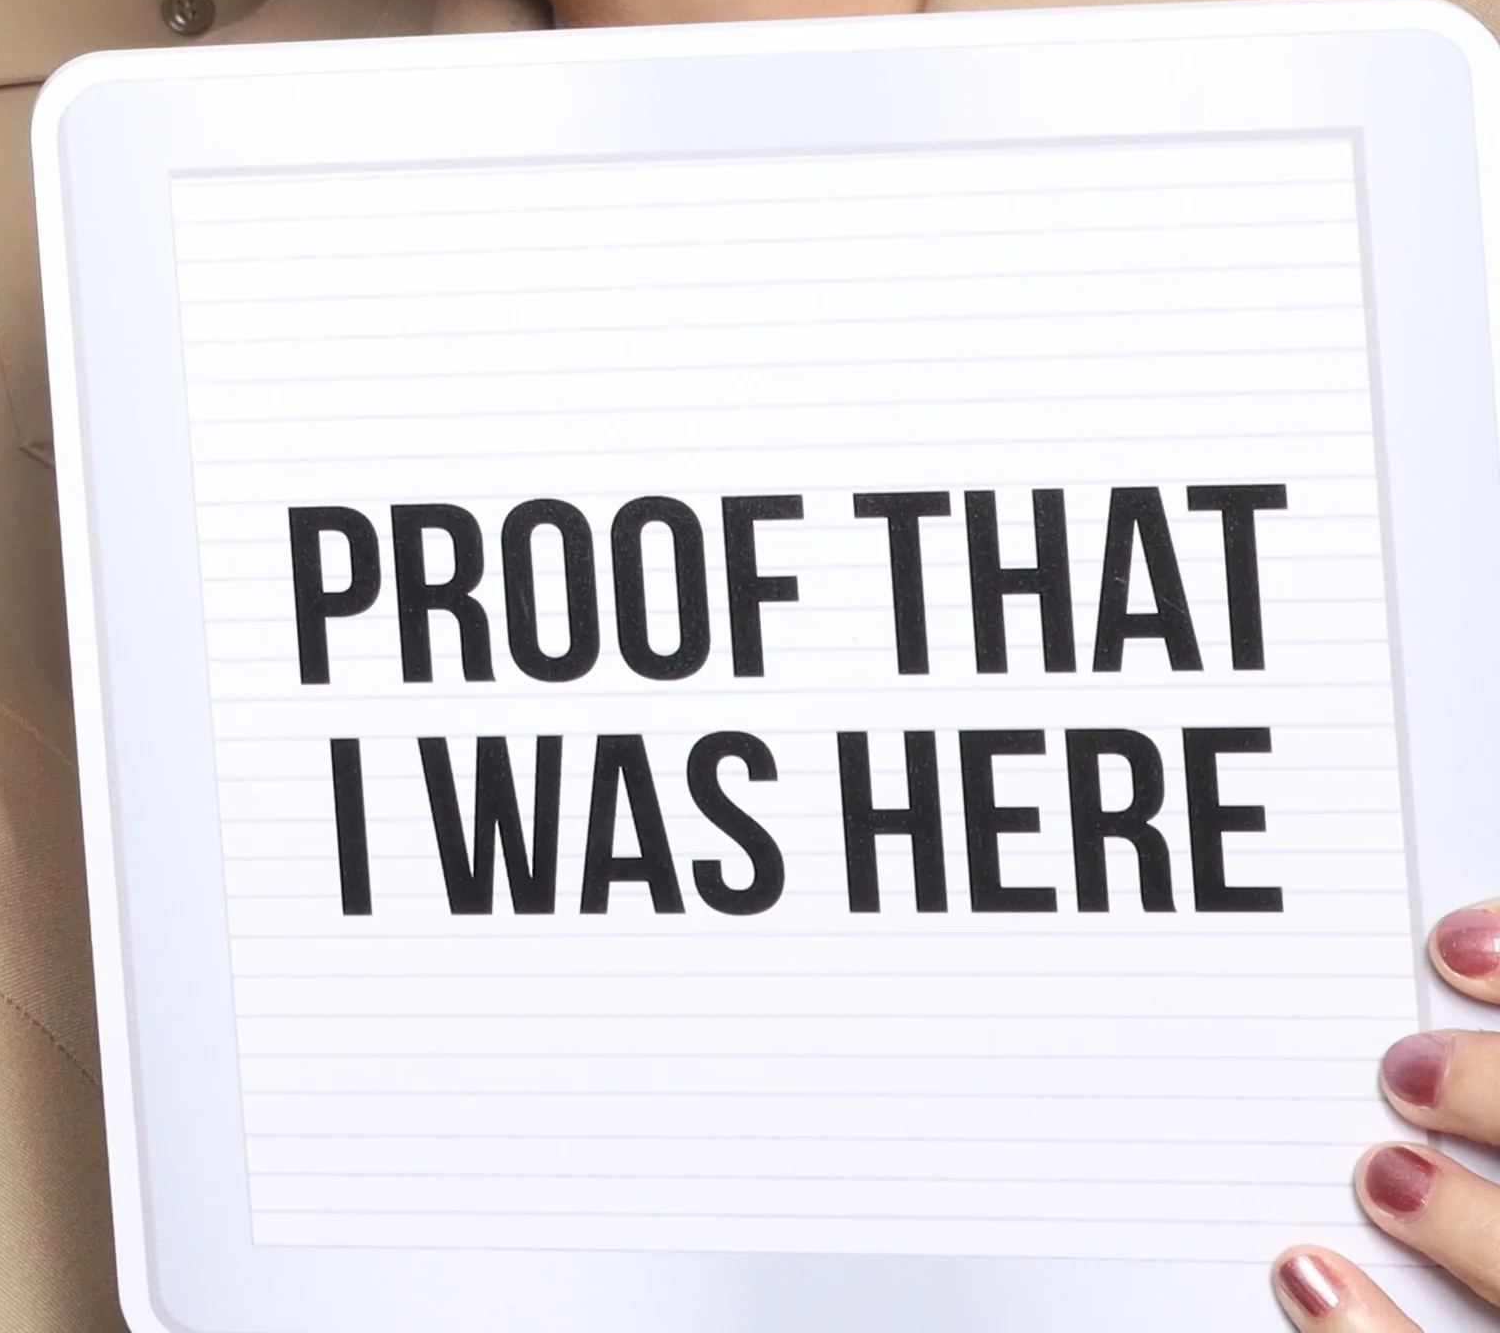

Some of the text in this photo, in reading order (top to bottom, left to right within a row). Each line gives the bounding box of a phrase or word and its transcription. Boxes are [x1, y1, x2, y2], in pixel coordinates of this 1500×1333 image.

[287, 484, 1288, 684] PROOF THAT
[330, 728, 1286, 916] I WAS HERE
